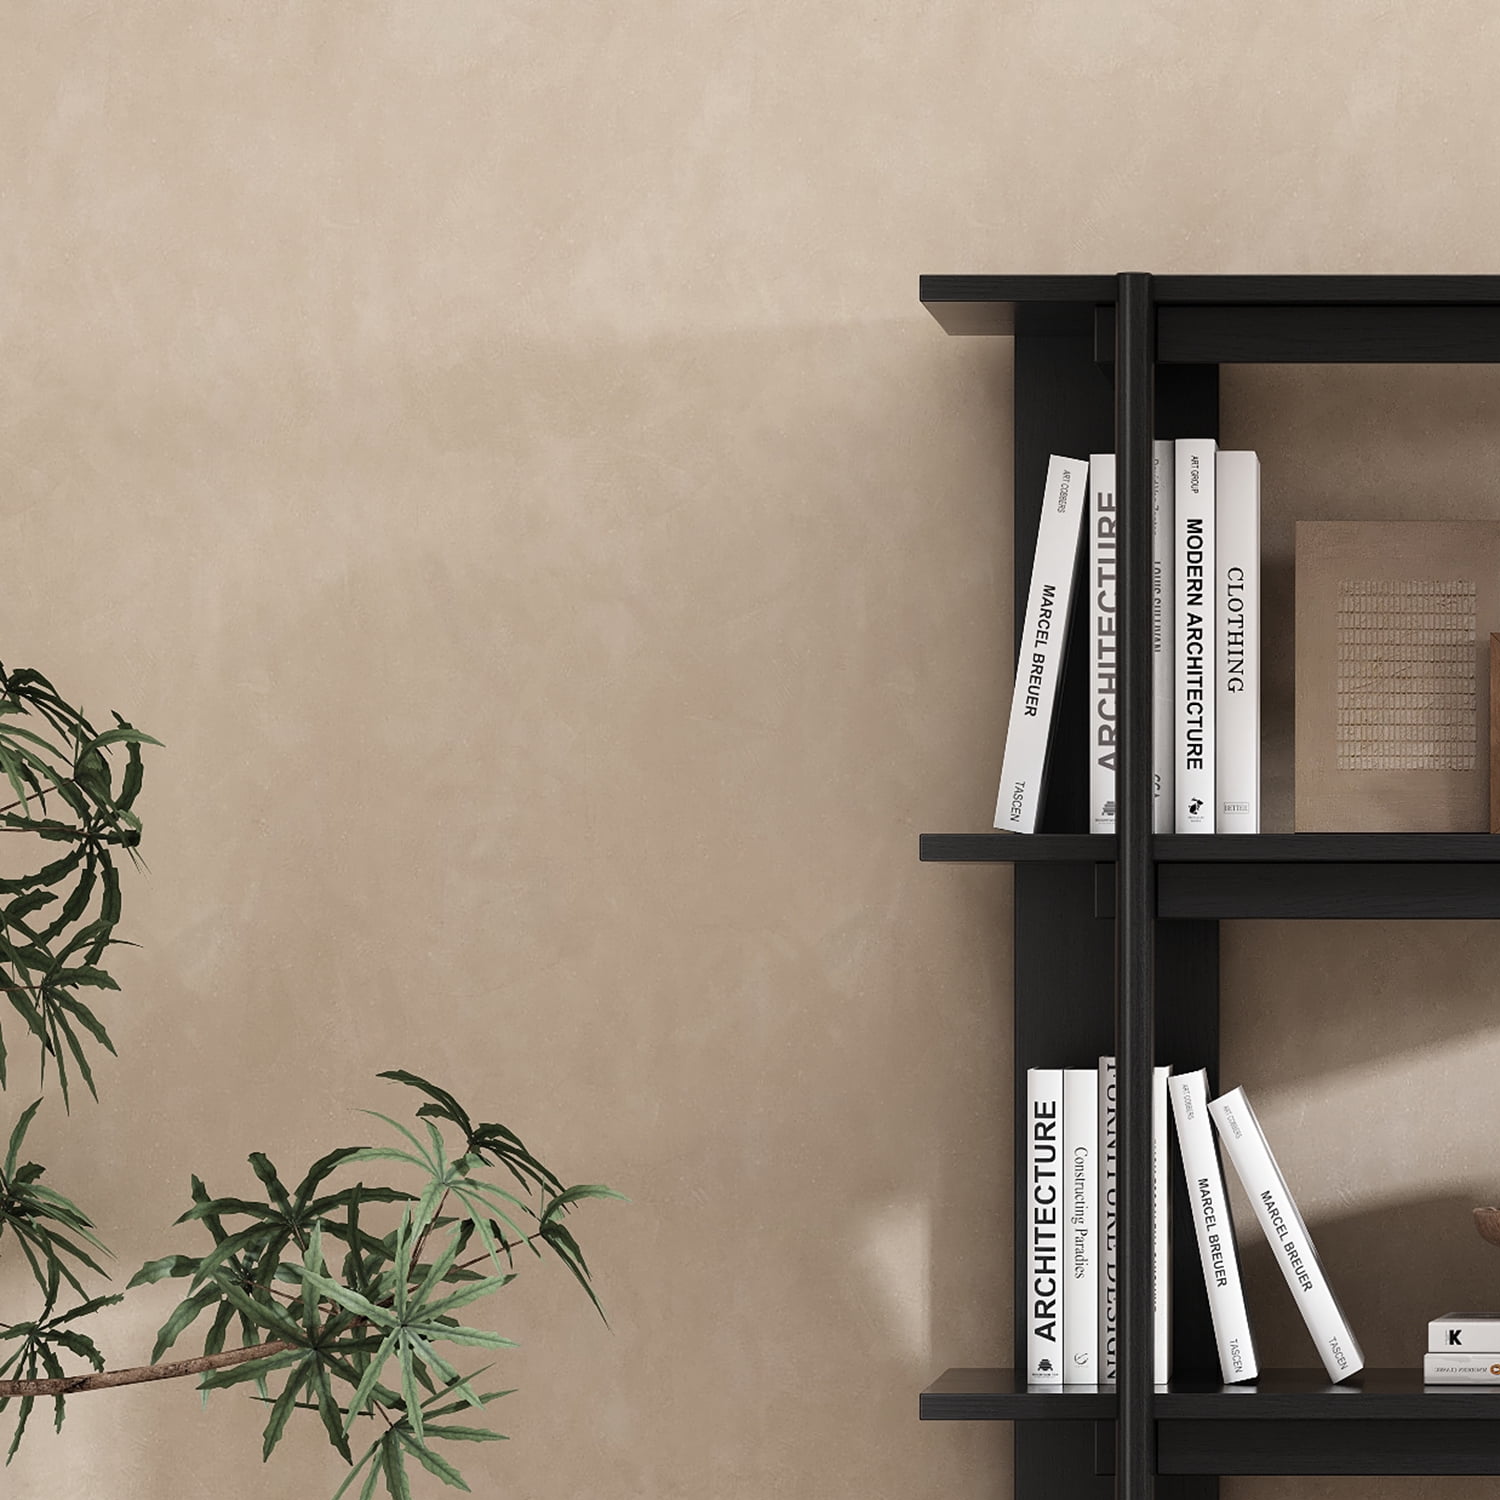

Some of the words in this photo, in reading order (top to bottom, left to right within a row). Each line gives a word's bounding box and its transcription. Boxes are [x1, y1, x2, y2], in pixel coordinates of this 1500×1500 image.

[1186, 518, 1204, 607] MODERN
[1034, 584, 1056, 649] MARCEL
[1227, 566, 1245, 694] CLOTHING
[1024, 653, 1046, 718] BREUER
[1186, 612, 1204, 770] ARCHITECTURE
[1010, 780, 1026, 823] TASCEN
[1033, 1100, 1057, 1343] ARCHITECTURE
[1071, 1146, 1089, 1224] Constructing
[1197, 1178, 1215, 1232] MARCEL
[1208, 1234, 1228, 1288] BREUER
[1260, 1190, 1289, 1242] MARCEL
[1283, 1241, 1313, 1293] BREUER
[1229, 1338, 1244, 1374] TASCEN
[1328, 1336, 1349, 1371] TASCEN
